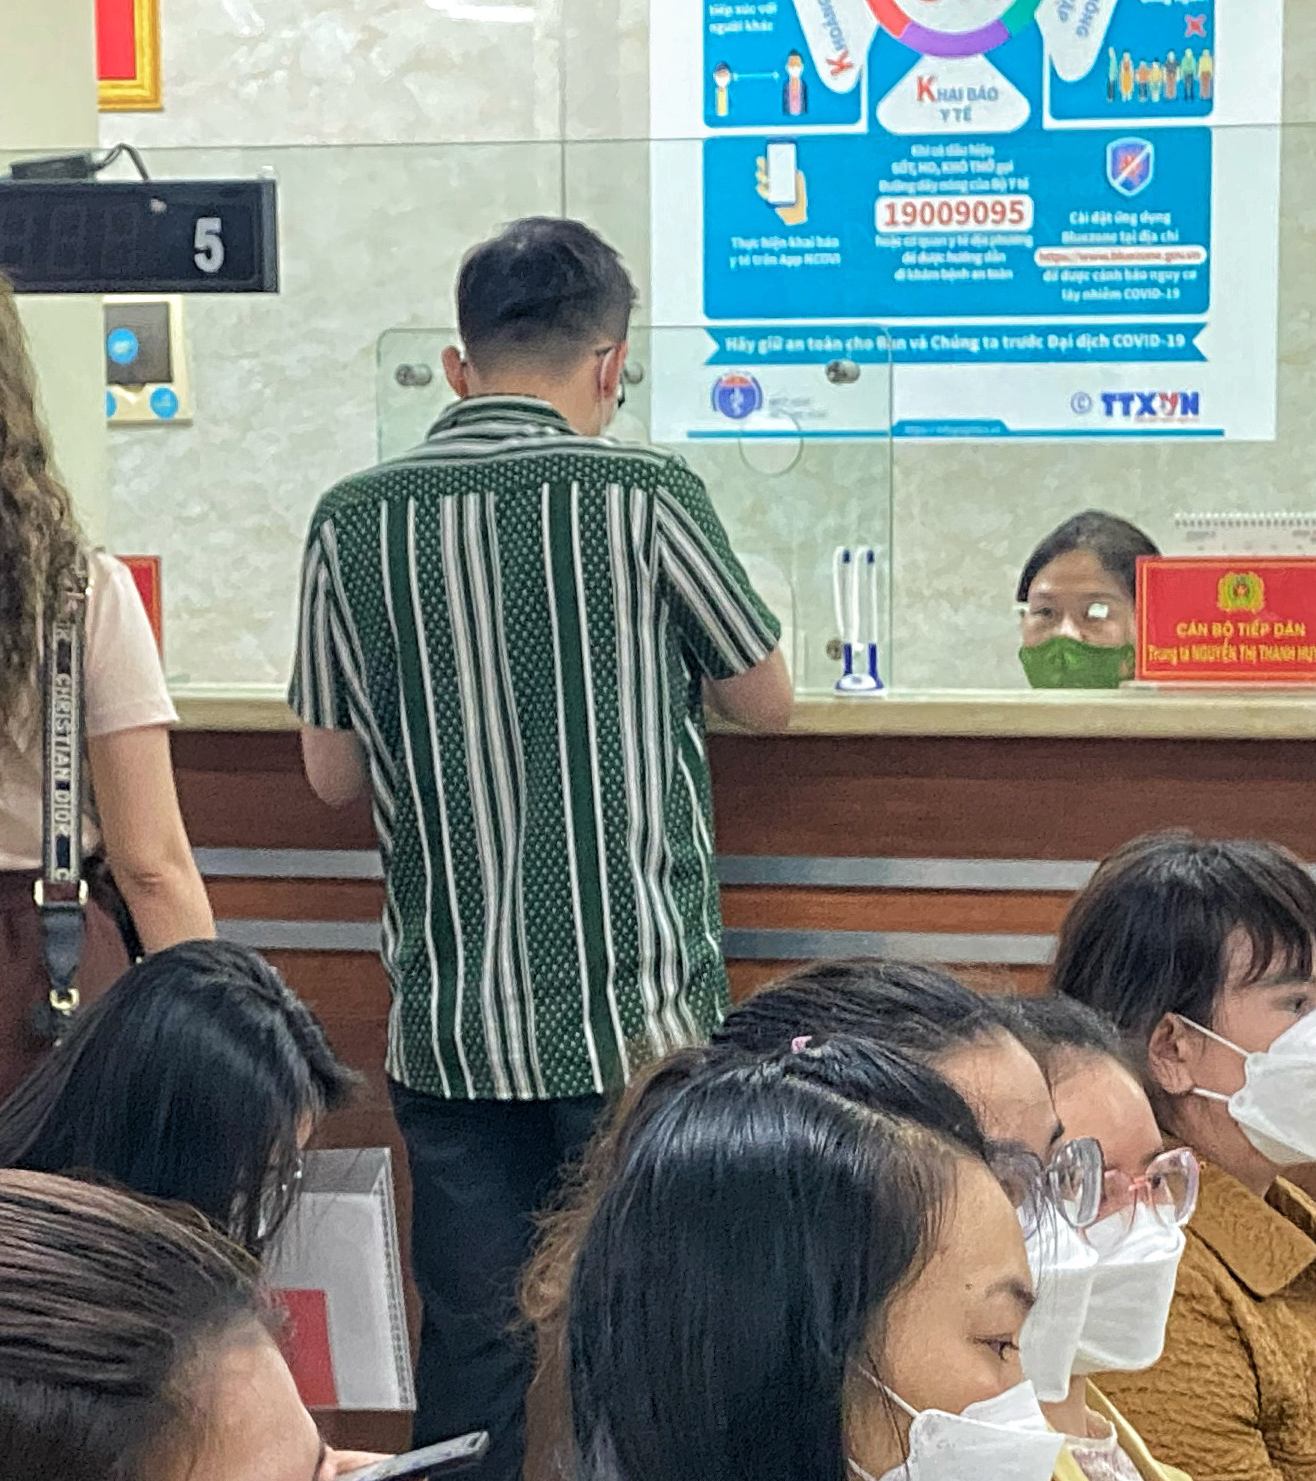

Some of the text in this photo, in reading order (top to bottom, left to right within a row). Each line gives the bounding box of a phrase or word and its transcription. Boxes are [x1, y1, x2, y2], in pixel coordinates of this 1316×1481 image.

[916, 75, 963, 102] KHAI
[883, 199, 1025, 226] 19009095
[193, 216, 225, 274] 5
